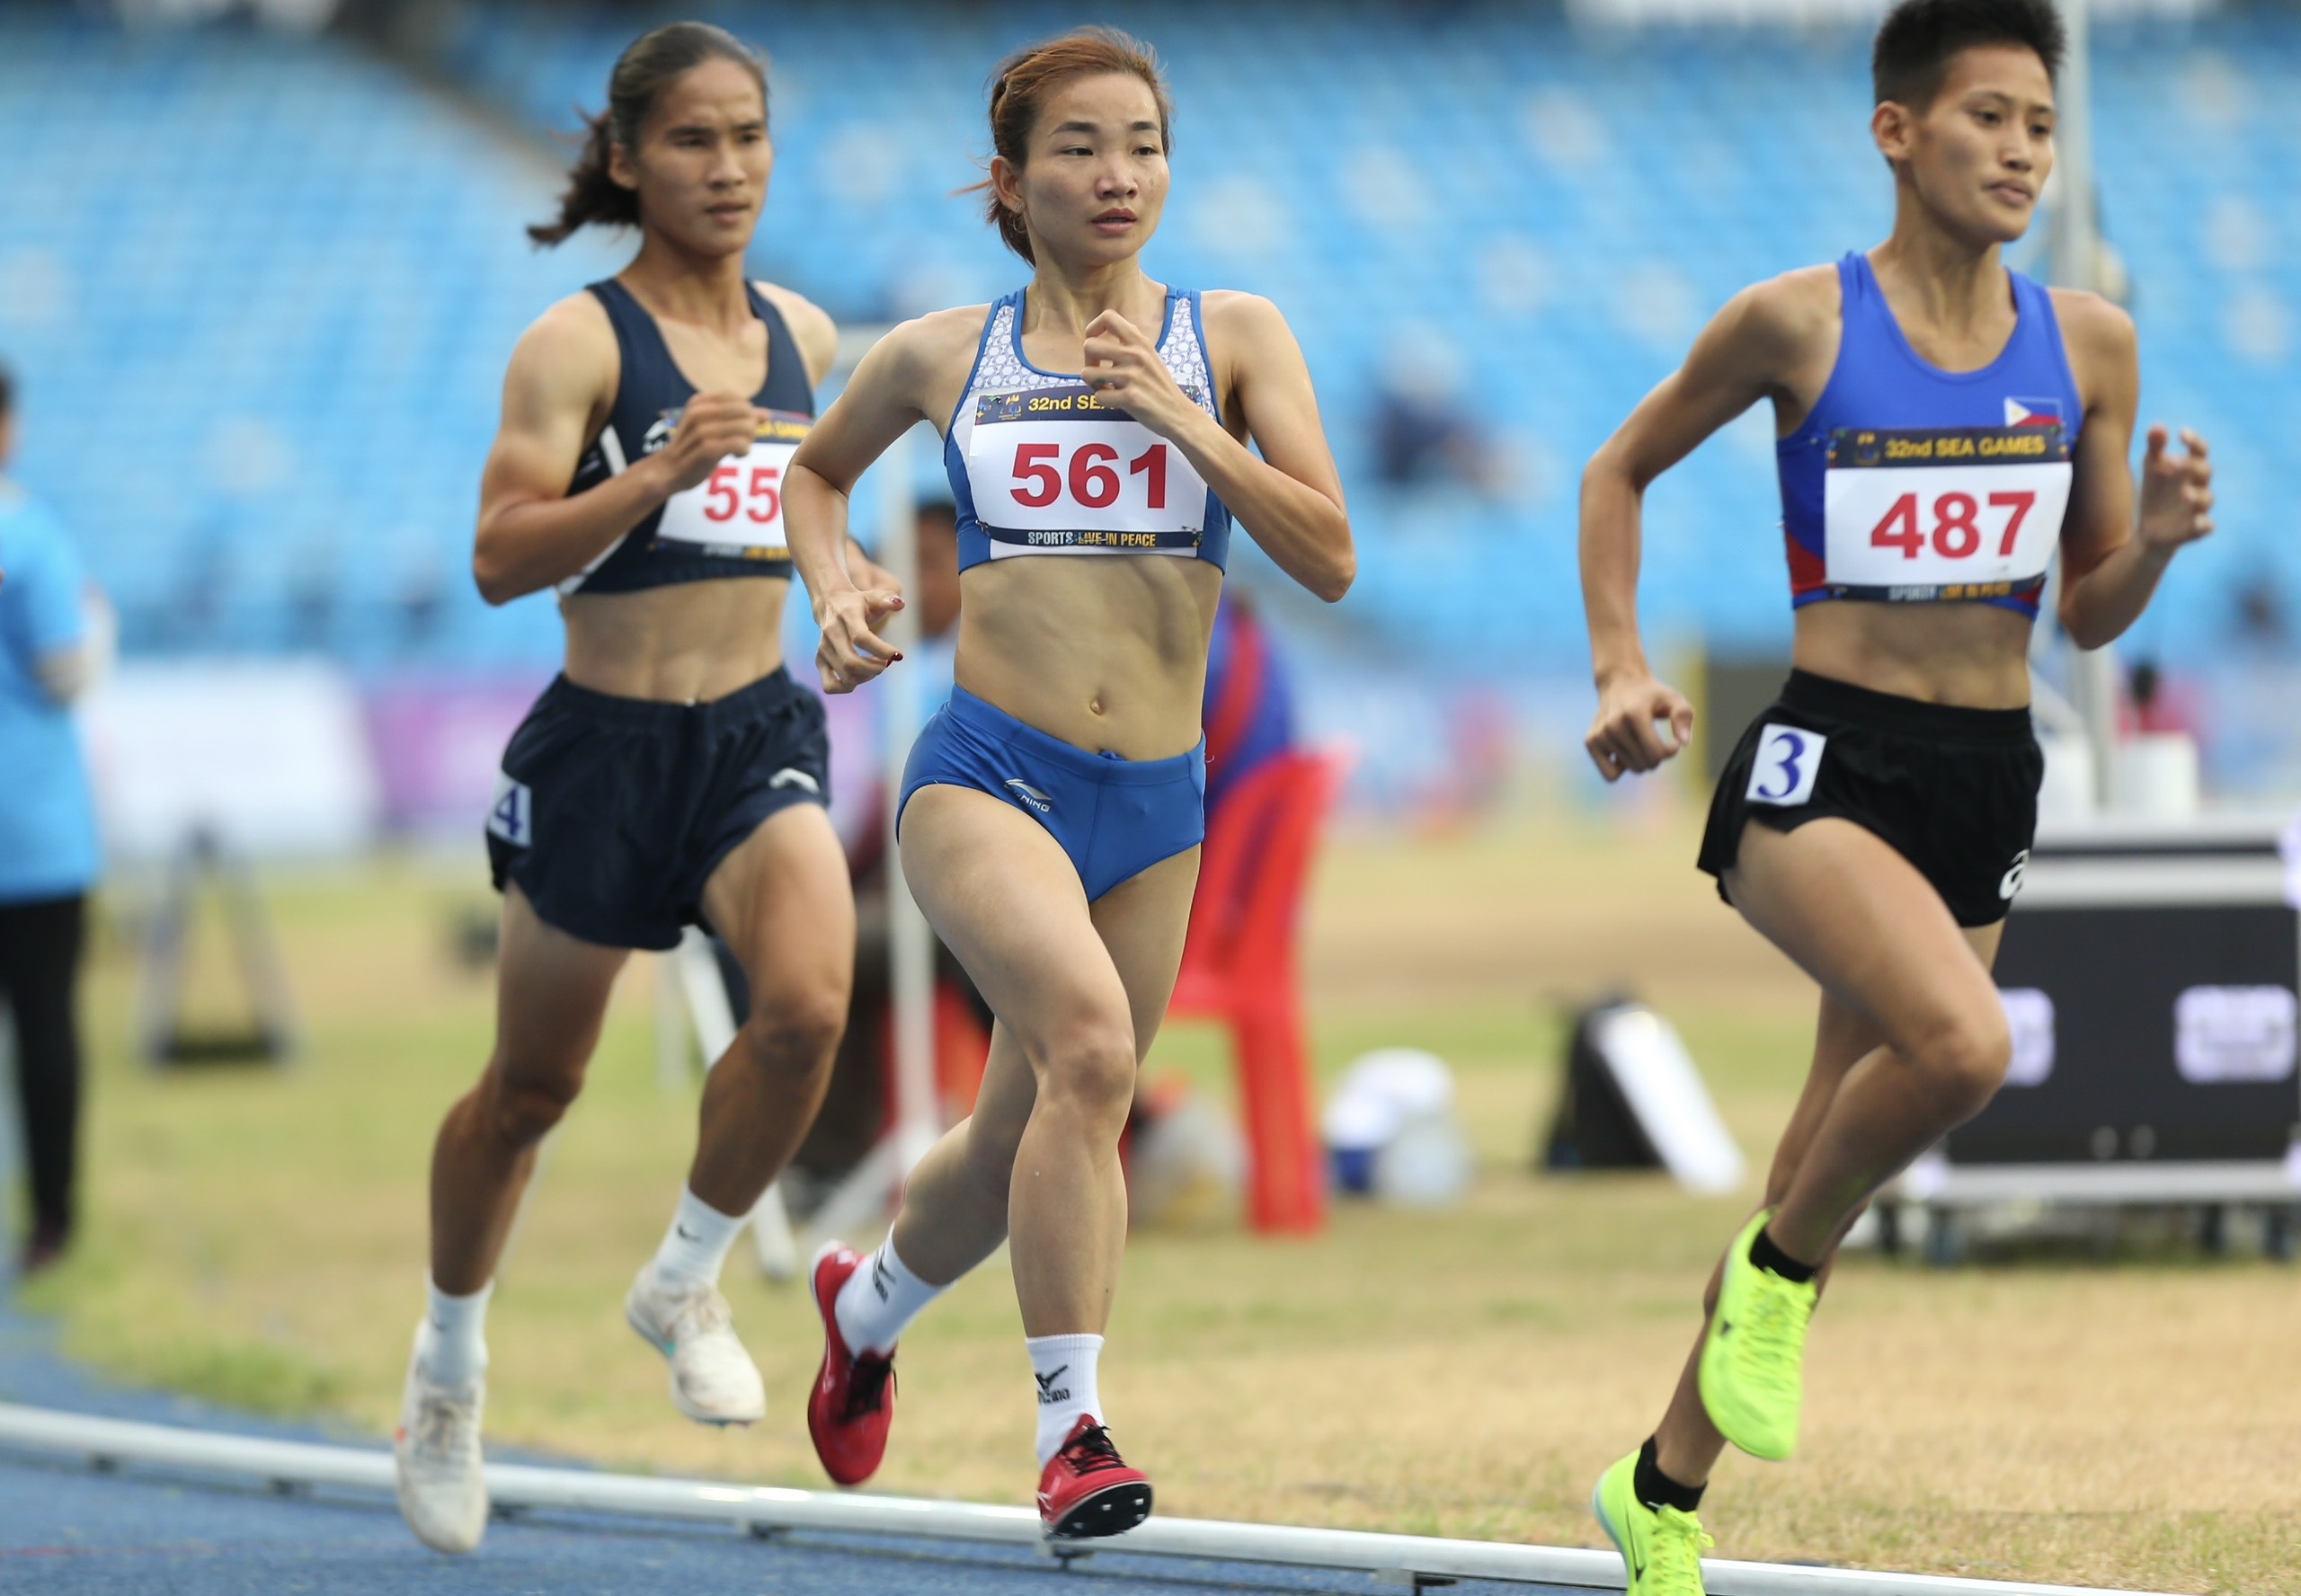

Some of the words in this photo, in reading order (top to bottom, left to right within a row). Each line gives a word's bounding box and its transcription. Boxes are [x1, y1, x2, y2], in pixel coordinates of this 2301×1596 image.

[1028, 395, 1072, 412] 32nd
[1077, 395, 1114, 410] SE
[1885, 439, 1932, 459] 32nd
[1935, 438, 1976, 458] SEA
[1979, 435, 2047, 457] GAMES
[704, 466, 781, 524] 55
[1009, 443, 1168, 509] 561
[1028, 531, 1073, 545] SPORTS
[1121, 533, 1156, 547] PEACE
[1870, 491, 2037, 560] 487
[1757, 732, 1807, 800] 3
[494, 784, 523, 837] 4
